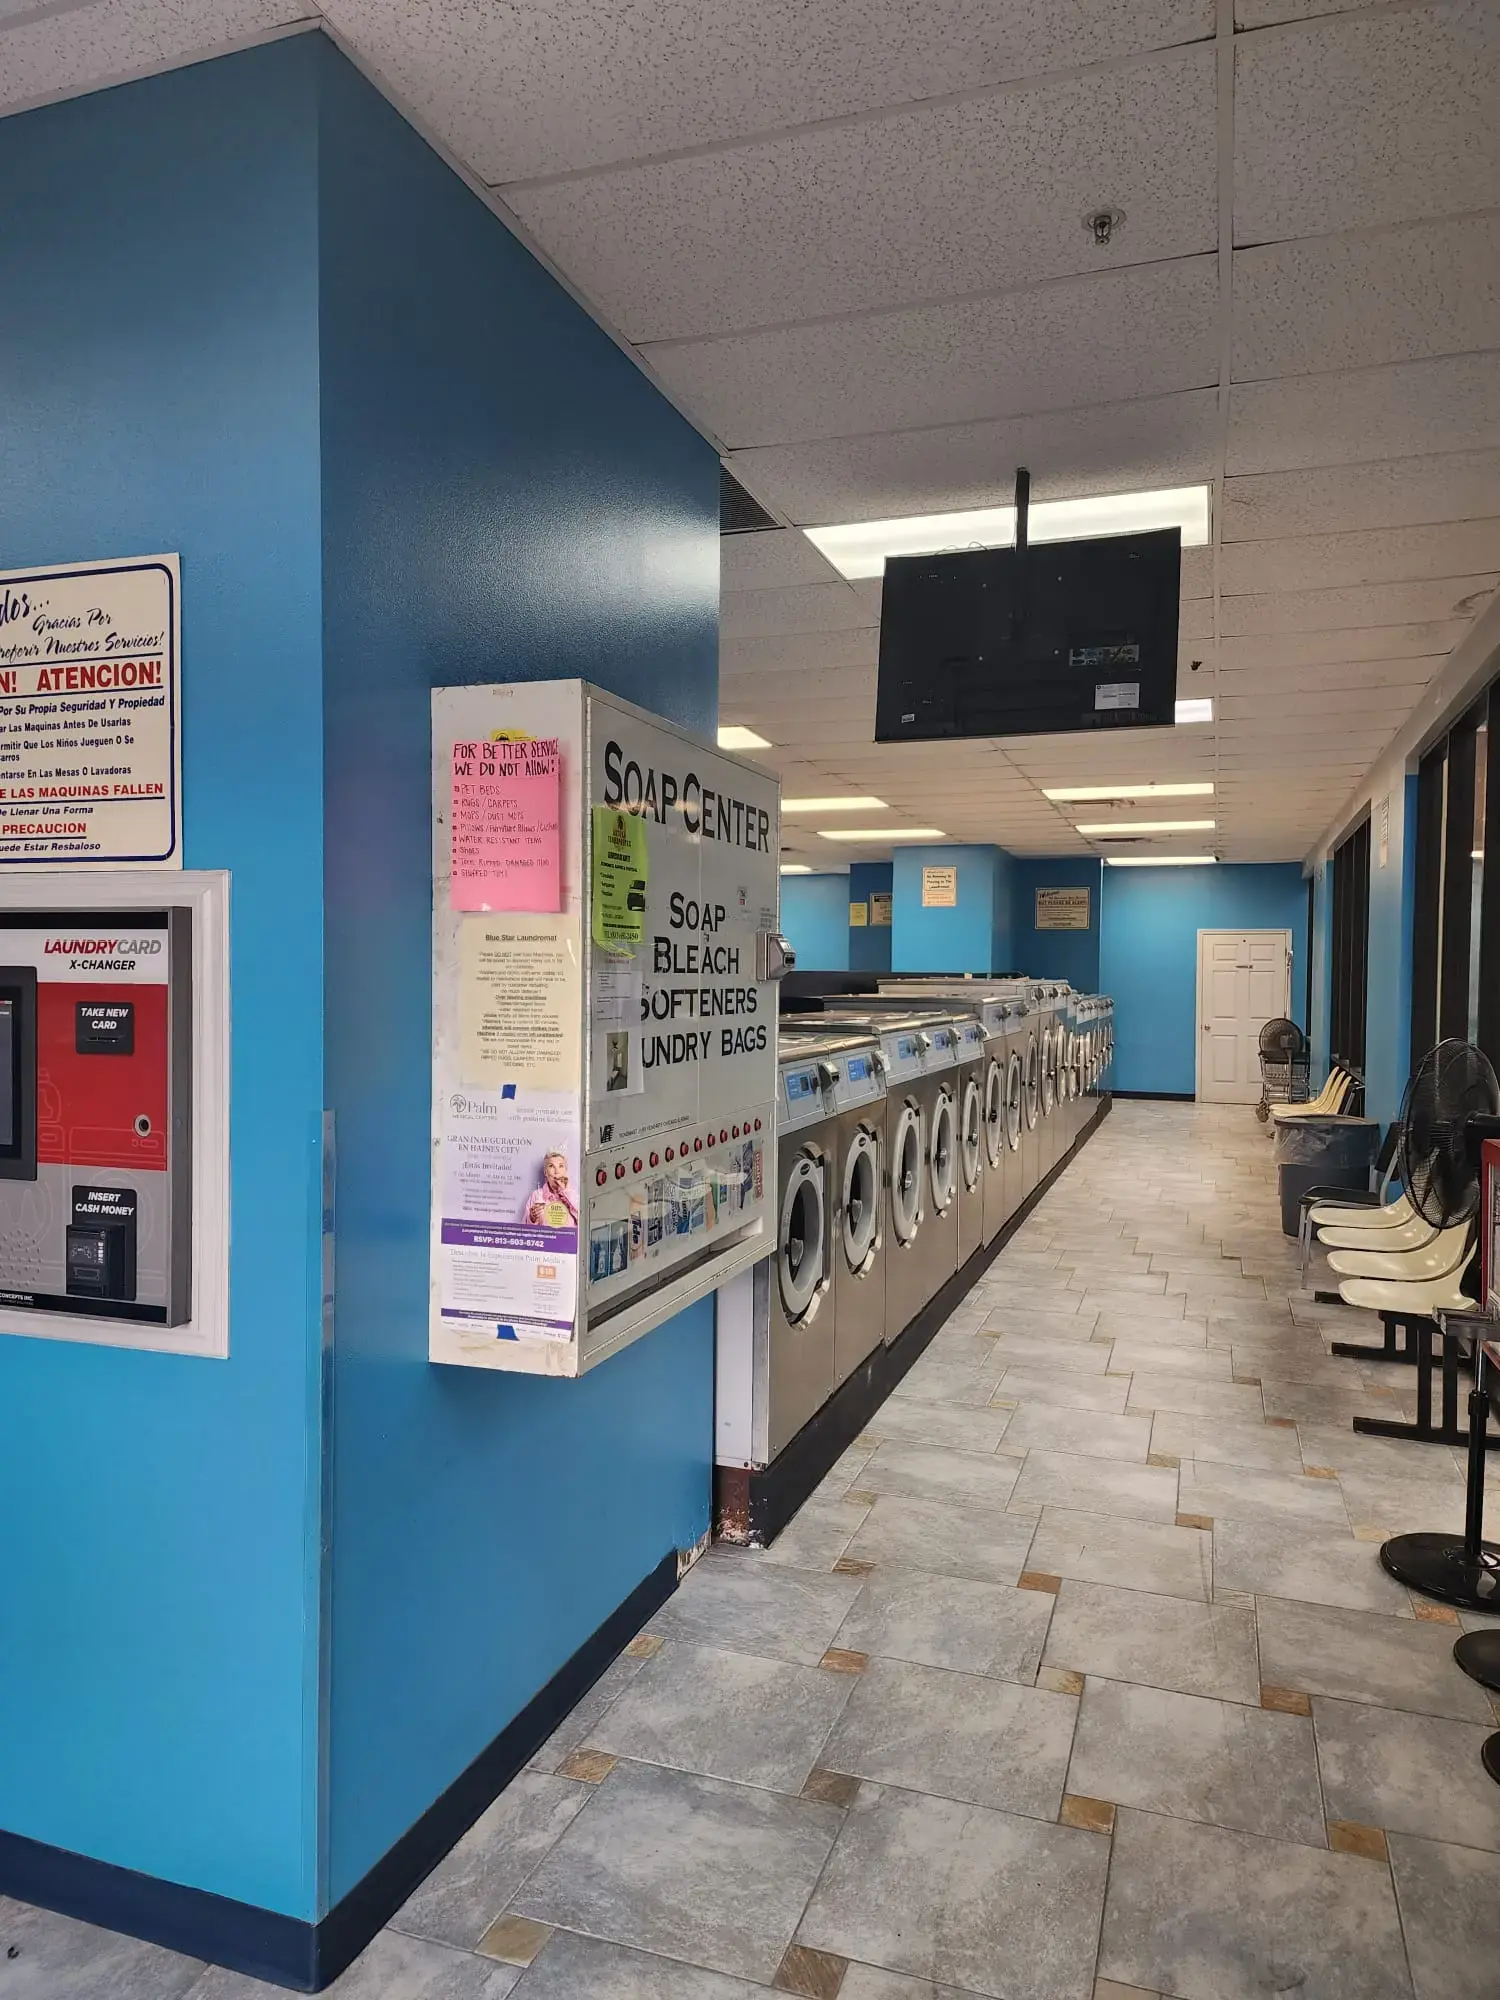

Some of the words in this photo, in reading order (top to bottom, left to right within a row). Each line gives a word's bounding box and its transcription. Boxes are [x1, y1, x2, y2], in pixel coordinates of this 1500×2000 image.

[32, 614, 81, 636] Gracias
[86, 607, 113, 627] Por
[44, 636, 100, 655] Nuestros
[105, 632, 164, 652] Servicios!
[36, 661, 161, 691] ATENCION!
[15, 704, 26, 715] Su
[29, 702, 57, 716] Propia
[60, 699, 106, 714] Seguridad
[109, 698, 116, 709] Y
[118, 695, 165, 710] Propiedad
[8, 723, 22, 733] Las
[25, 721, 61, 733] Maquinas
[63, 719, 86, 730] Antes
[88, 718, 99, 729] De
[101, 717, 132, 727] Usarlas
[23, 740, 38, 750] Que
[40, 739, 54, 748] Los
[56, 738, 78, 748] Niños
[80, 736, 114, 748] Jueguen
[116, 736, 122, 745] O
[124, 735, 134, 744] Se
[0, 754, 20, 762] arros
[453, 743, 477, 759] FOR
[27, 769, 37, 779] En
[39, 769, 53, 778] Las
[55, 767, 79, 777] Mesas
[82, 766, 88, 776] O
[91, 765, 131, 776] Lavadoras
[454, 761, 472, 775] WE
[480, 761, 495, 776] DO
[499, 762, 520, 776] NOT
[11, 788, 35, 799] LAS
[39, 785, 109, 798] MAQUINAS
[113, 783, 163, 795] FALLEN
[480, 784, 500, 795] BEDS
[10, 807, 39, 816] Llenar
[42, 806, 60, 815] Una
[63, 806, 93, 815] Forma
[683, 772, 769, 853] CENTER
[2, 823, 86, 834] PRECAUCION
[24, 843, 48, 852] Estar
[51, 842, 101, 851] Resbaloso
[69, 959, 136, 971] X-CHANGER
[81, 1008, 104, 1017] TAKE
[106, 1008, 128, 1018] NEW
[91, 1020, 117, 1030] CARD
[721, 1024, 767, 1057] BAGS
[468, 1101, 497, 1114] Palm
[88, 1191, 121, 1203] INSERT
[75, 1203, 100, 1213] CASH
[101, 1205, 134, 1216] MONEY
